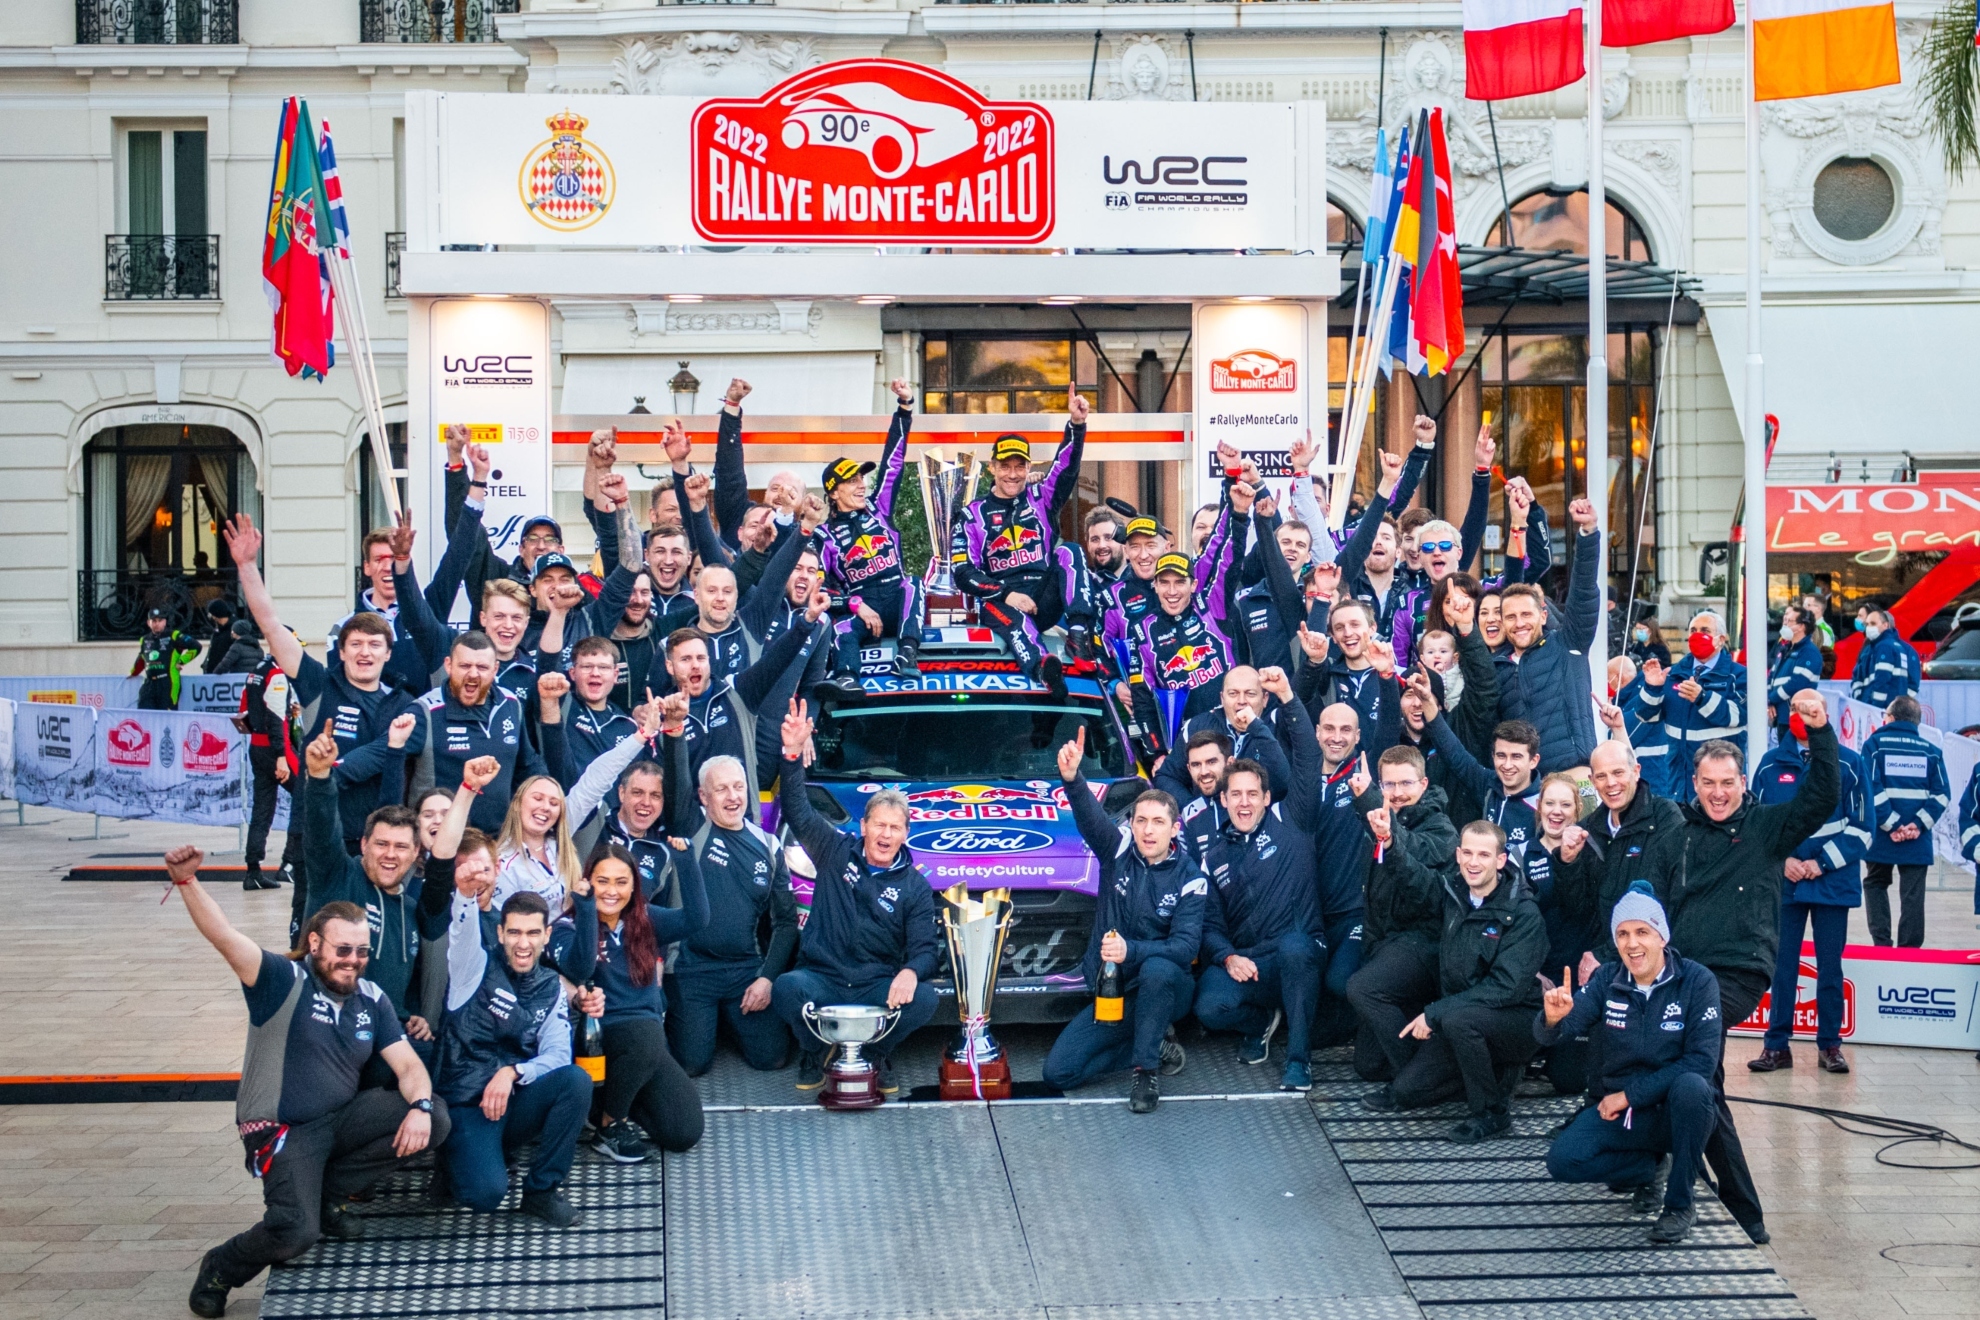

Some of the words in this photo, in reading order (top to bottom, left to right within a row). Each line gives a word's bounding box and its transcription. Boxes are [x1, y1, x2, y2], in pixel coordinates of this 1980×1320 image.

[713, 114, 768, 164] 2022
[983, 115, 1036, 163] 2022
[1103, 155, 1248, 186] WRC
[710, 147, 812, 221] RALLYE
[823, 153, 1037, 222] MONTE-CARLO
[1137, 194, 1156, 202] FIA
[444, 355, 533, 373] WRC
[1213, 370, 1239, 389] RALLYE
[1241, 370, 1294, 389] MONTE-CARLO
[1210, 414, 1298, 427] #RallyeMonteCarlo
[1771, 516, 1848, 548] Le
[847, 562, 877, 583] Red
[874, 549, 898, 571] Bull
[988, 550, 1019, 572] Red
[1018, 544, 1043, 565] Bull
[1197, 658, 1224, 685] Bull
[980, 804, 1058, 821] Bull
[931, 829, 1026, 852] Ford
[936, 865, 1055, 879] SafetyCulture
[1878, 985, 1956, 1005] WRC
